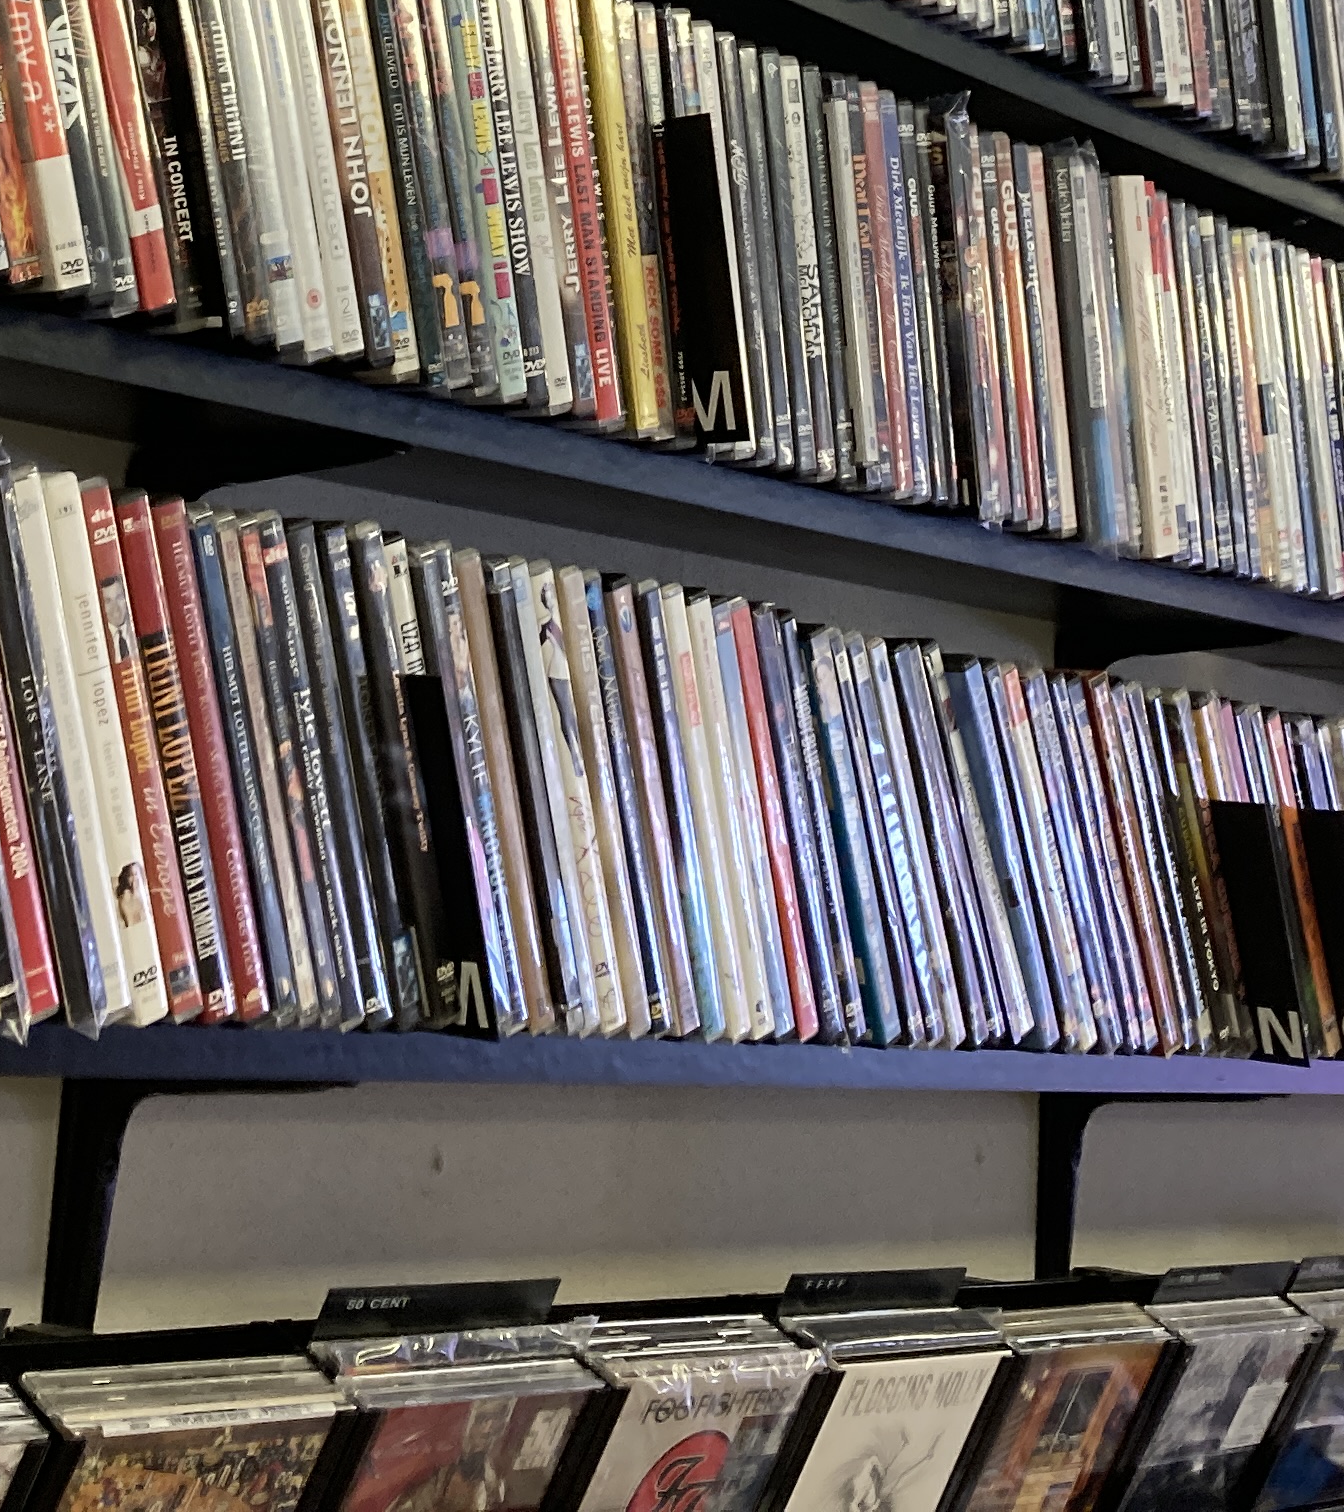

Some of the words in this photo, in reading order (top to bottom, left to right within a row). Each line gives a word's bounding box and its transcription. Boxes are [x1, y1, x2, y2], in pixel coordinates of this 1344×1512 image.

[319, 1, 360, 128] LENNON
[382, 37, 399, 89] LELIVELD
[494, 109, 513, 148] LEE
[543, 69, 560, 142] LEWIS
[568, 103, 586, 158] LEWIS
[162, 134, 178, 169] IN
[346, 133, 372, 218] JOHN
[551, 153, 570, 205] LEE
[167, 171, 194, 244] CONCERT
[498, 150, 521, 212] LEWIS
[505, 215, 532, 277] SHOW
[562, 214, 583, 293] JERRY
[578, 211, 595, 252] MAN
[582, 254, 608, 345] STANDING
[595, 347, 613, 390] LIVE
[691, 370, 737, 432] M
[19, 674, 40, 713] LOIS
[30, 744, 55, 805] LANE
[297, 687, 319, 734] lyle
[184, 889, 216, 961] HAMMER
[1257, 1006, 1305, 1056] N
[345, 1299, 365, 1311] 50
[369, 1297, 410, 1310] CENT
[842, 1372, 935, 1418] FLOGGING
[933, 1367, 992, 1412] MOLLY
